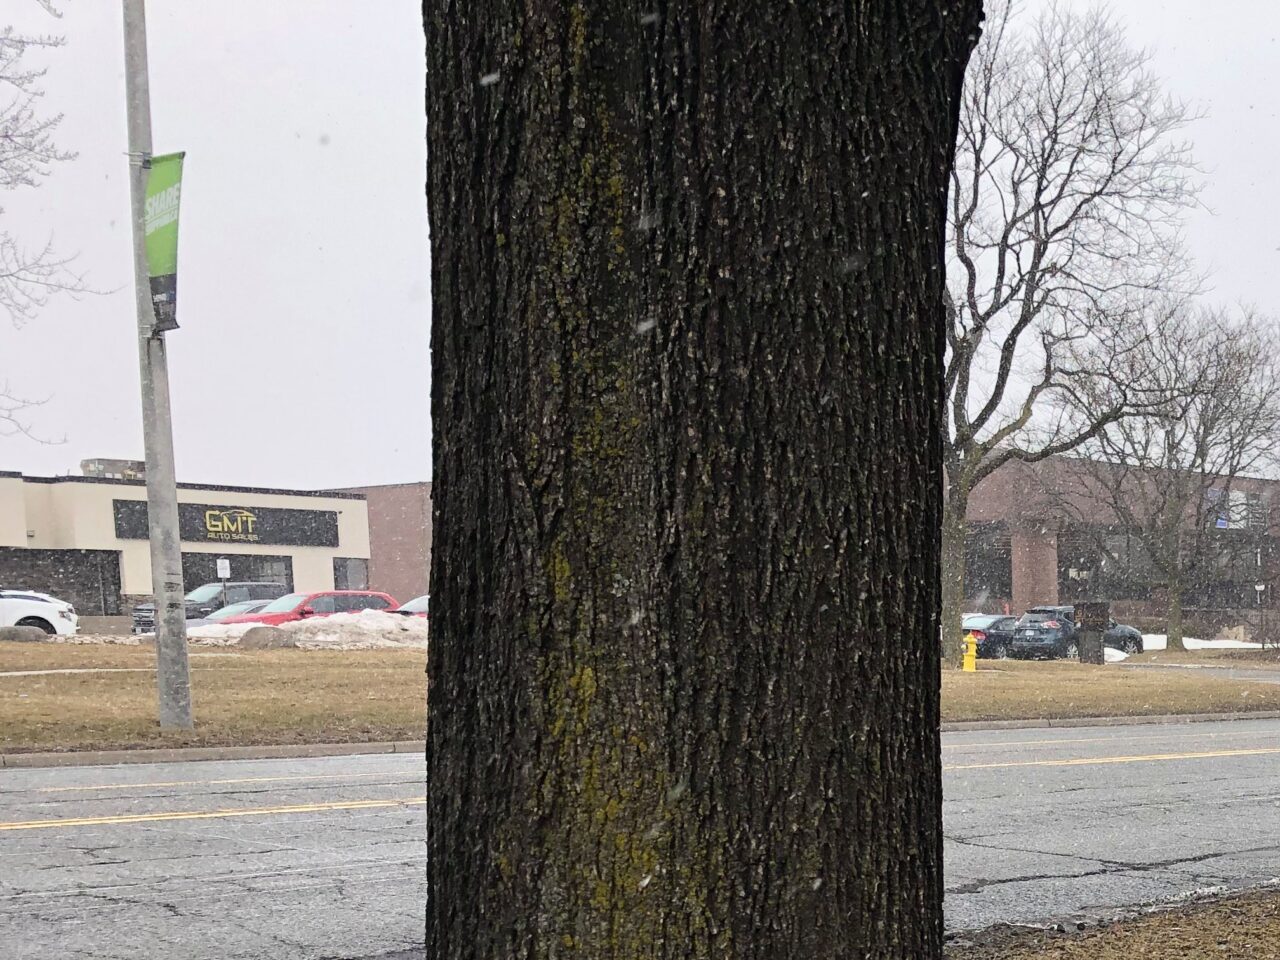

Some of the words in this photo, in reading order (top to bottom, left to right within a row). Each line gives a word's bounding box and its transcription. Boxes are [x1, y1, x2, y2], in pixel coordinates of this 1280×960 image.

[145, 182, 180, 218] SHARE
[206, 509, 257, 533] GMT
[207, 532, 231, 540] AUTO
